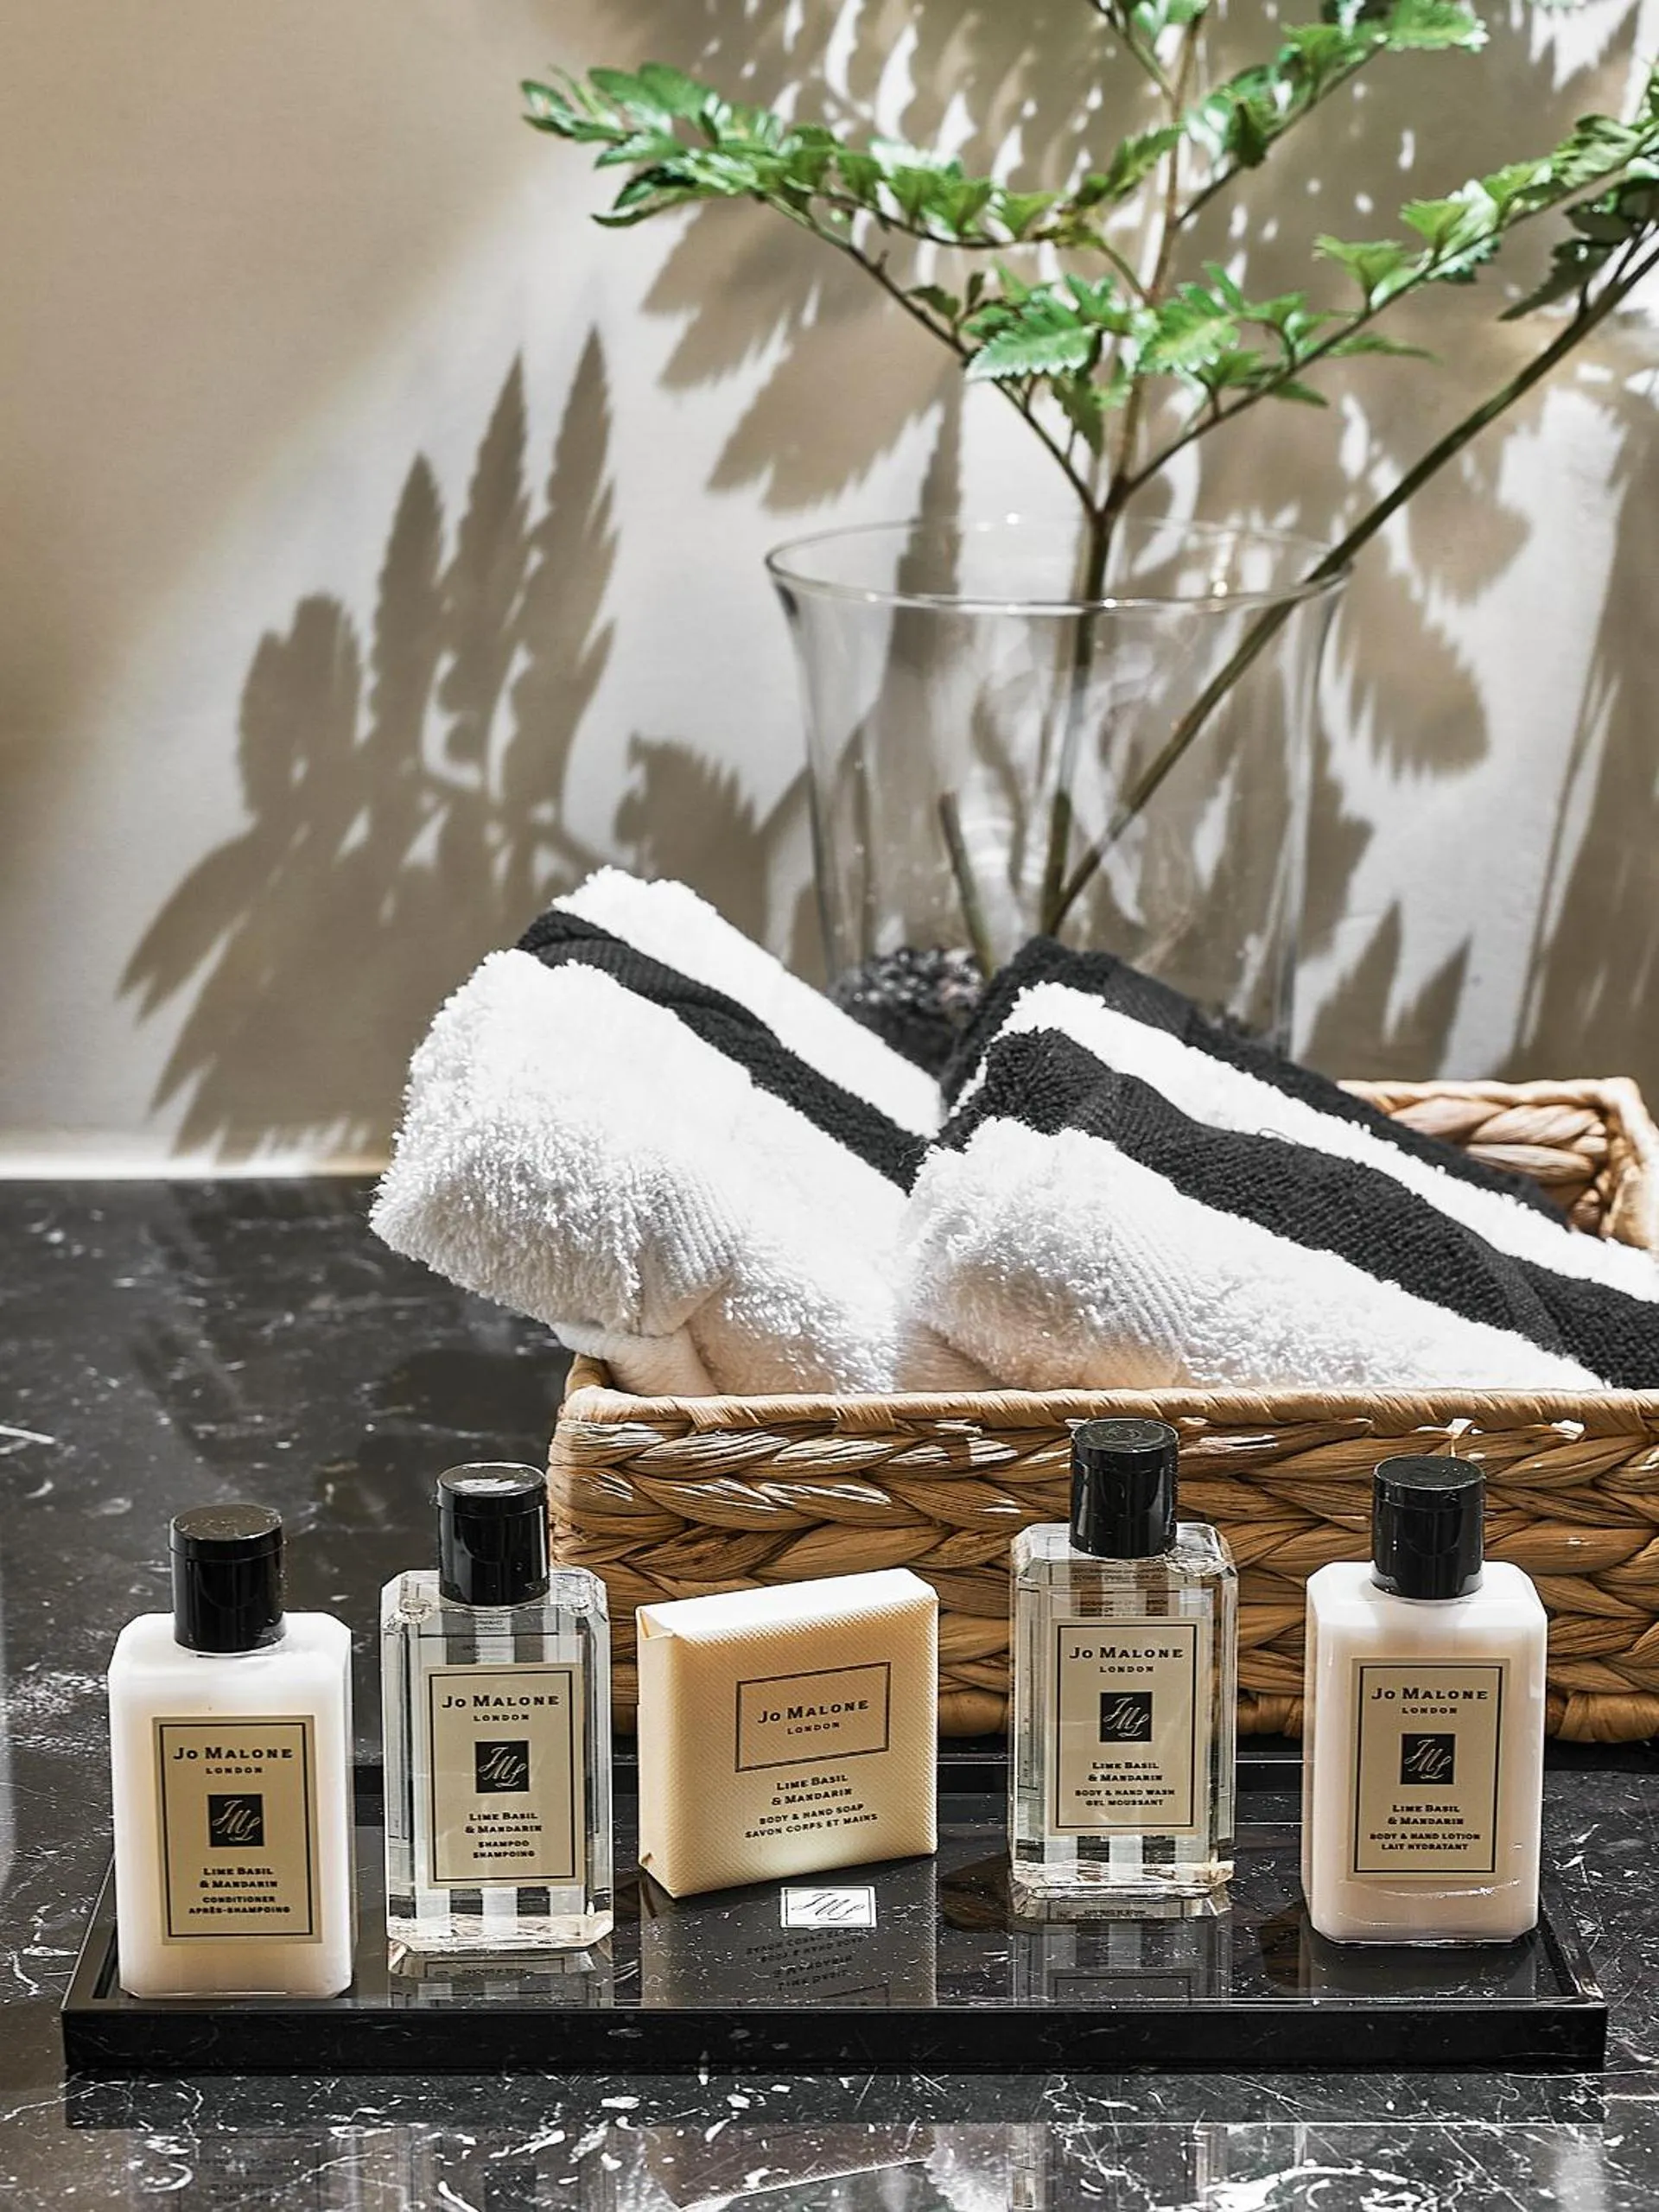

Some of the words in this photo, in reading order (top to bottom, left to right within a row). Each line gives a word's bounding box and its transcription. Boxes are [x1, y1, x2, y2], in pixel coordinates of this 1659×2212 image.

[1070, 1648, 1093, 1659] JO
[1100, 1647, 1183, 1658] MALONE
[1372, 1688, 1395, 1700] JO
[1402, 1688, 1488, 1700] MALONE
[442, 1696, 466, 1708] JO
[474, 1695, 559, 1707] MALONE
[758, 1711, 781, 1724] JO
[787, 1700, 869, 1719] MALONE
[787, 1722, 840, 1734] LONDON
[174, 1747, 198, 1760] JO
[205, 1747, 293, 1759] MALONE
[777, 1779, 808, 1790] LIME
[811, 1775, 848, 1786] BASIL
[785, 1788, 853, 1804] MANDARIN
[760, 1815, 788, 1825] BODY
[803, 1808, 833, 1819] HAND
[836, 1803, 864, 1814] SOAP
[745, 1827, 782, 1839] SAVON
[785, 1822, 823, 1833] CORPS
[843, 1814, 878, 1825] MAINS
